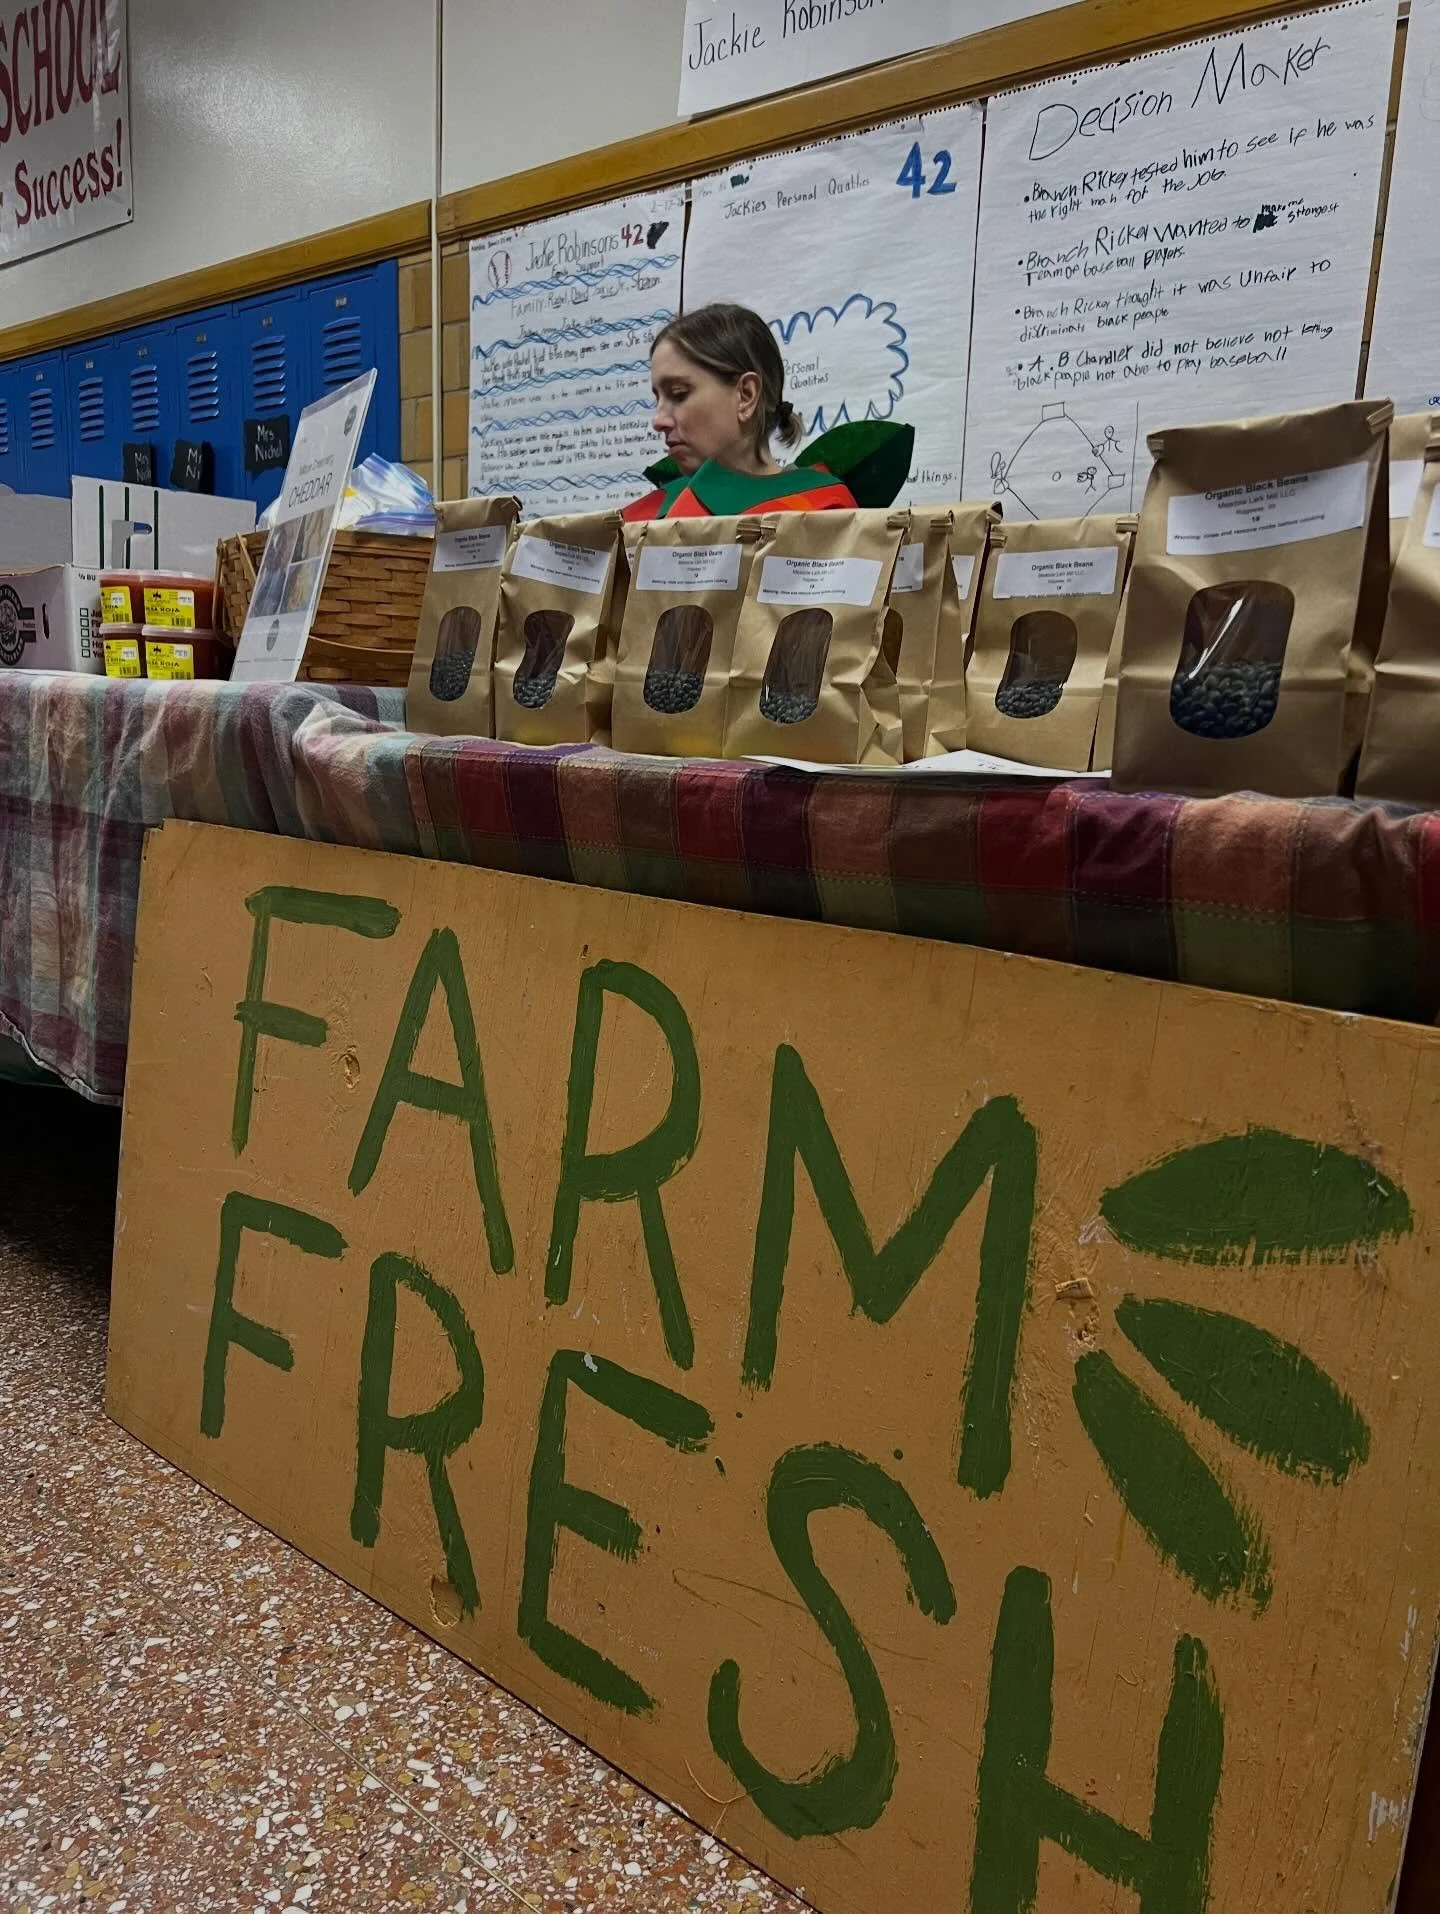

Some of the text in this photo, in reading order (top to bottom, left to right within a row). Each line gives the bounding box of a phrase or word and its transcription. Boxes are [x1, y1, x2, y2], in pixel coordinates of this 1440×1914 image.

[689, 0, 884, 70] Jackie Robins
[1029, 37, 1331, 160] Decision Maker
[1183, 148, 1214, 168] him
[1217, 139, 1238, 158] to
[1246, 132, 1278, 153] see
[1317, 118, 1336, 138] he
[1345, 114, 1375, 131] was
[15, 118, 123, 228] Success!
[896, 141, 957, 199] 42
[1162, 179, 1186, 194] the
[777, 184, 816, 208] Personal
[621, 223, 644, 249] 42
[1026, 240, 1088, 271] Branch
[1232, 215, 1251, 229] to
[1023, 300, 1068, 320] Branch
[1173, 284, 1187, 296] it
[1198, 275, 1232, 294] was
[1310, 259, 1331, 274] to
[1141, 339, 1163, 359] did
[1174, 340, 1199, 356] not
[1206, 332, 1255, 350] believe
[1264, 325, 1293, 342] not
[1096, 368, 1115, 380] not
[1157, 358, 1171, 372] to
[257, 425, 275, 442] Mrs
[289, 472, 333, 508] CHEDDAR
[1204, 475, 1308, 501] Organic Black Beans
[672, 551, 692, 559] Organic
[786, 559, 811, 568] Organic
[1031, 563, 1054, 572] Organic
[233, 886, 1037, 1500] FARM
[198, 1190, 1225, 1914] FRESH
